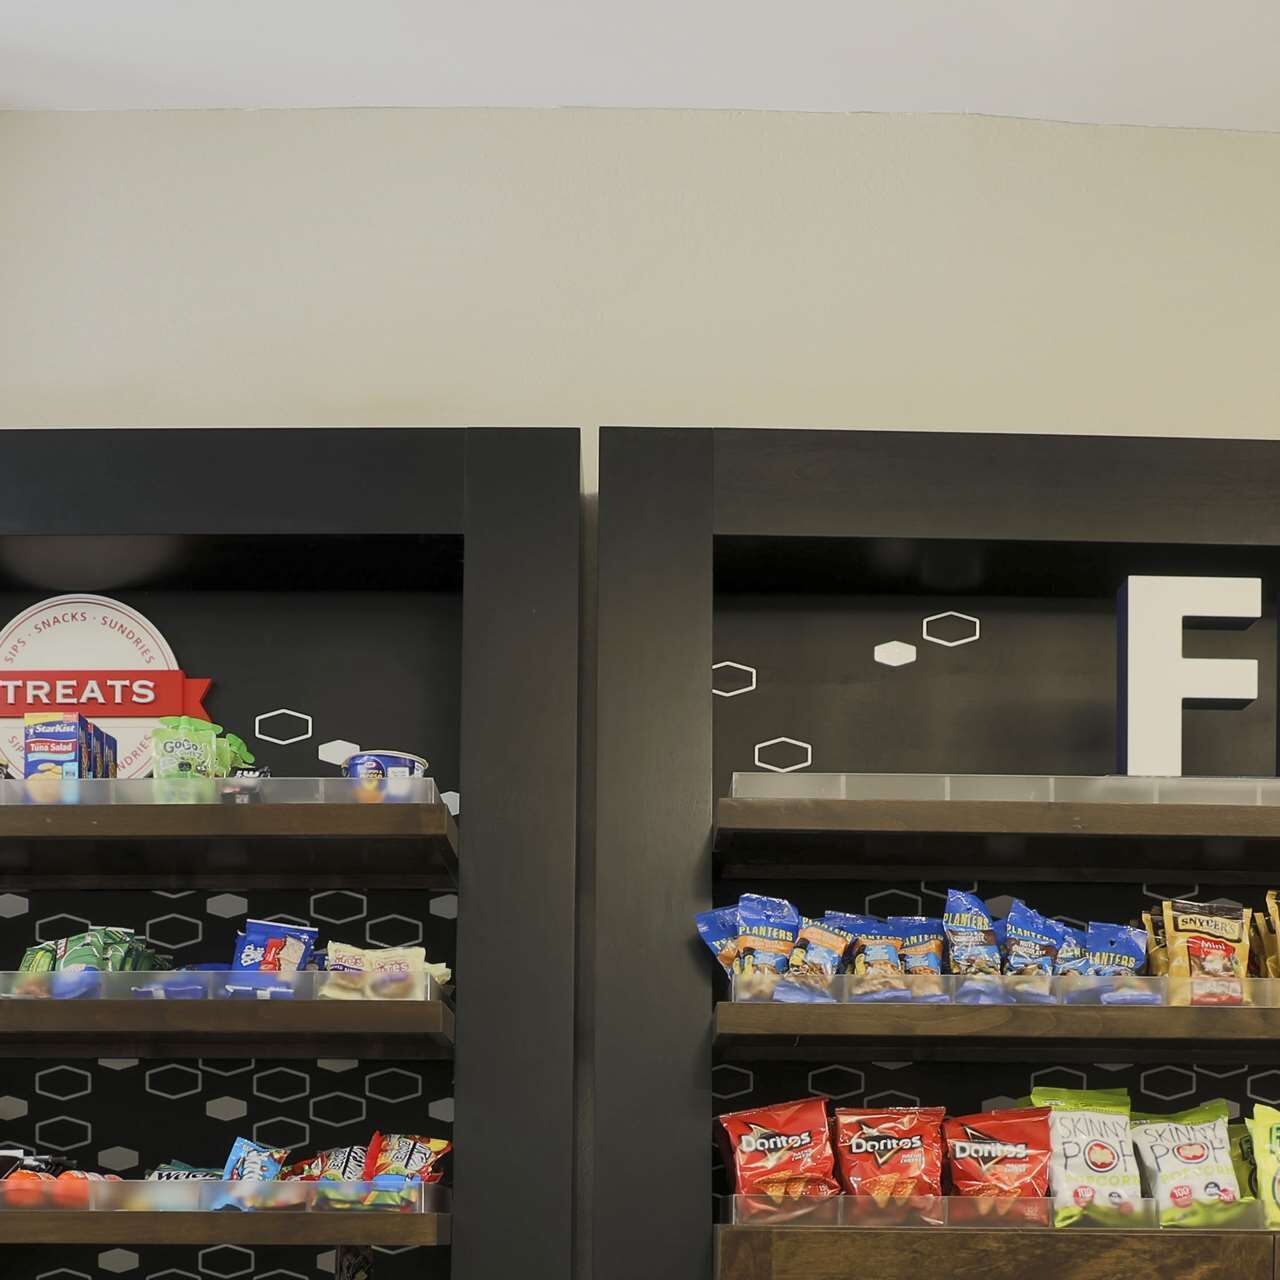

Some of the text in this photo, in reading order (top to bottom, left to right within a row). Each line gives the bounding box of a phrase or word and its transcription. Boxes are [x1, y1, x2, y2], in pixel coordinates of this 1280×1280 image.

[4, 611, 156, 665] SIPS SNACKS SUNDRIES
[0, 679, 157, 705] TREATS
[30, 743, 72, 752] Tuna Salad
[116, 732, 154, 771] NDRIES
[943, 912, 990, 930] PLANTERS
[740, 926, 793, 941] PLANTERS
[1201, 940, 1226, 951] Mini
[1089, 951, 1137, 968] LANTERS
[1059, 1113, 1130, 1140] SKINNY
[1144, 1123, 1220, 1144] SKINNY
[741, 1131, 813, 1154] Doritos
[851, 1133, 923, 1155] Doritos
[953, 1140, 1029, 1161] Doritos
